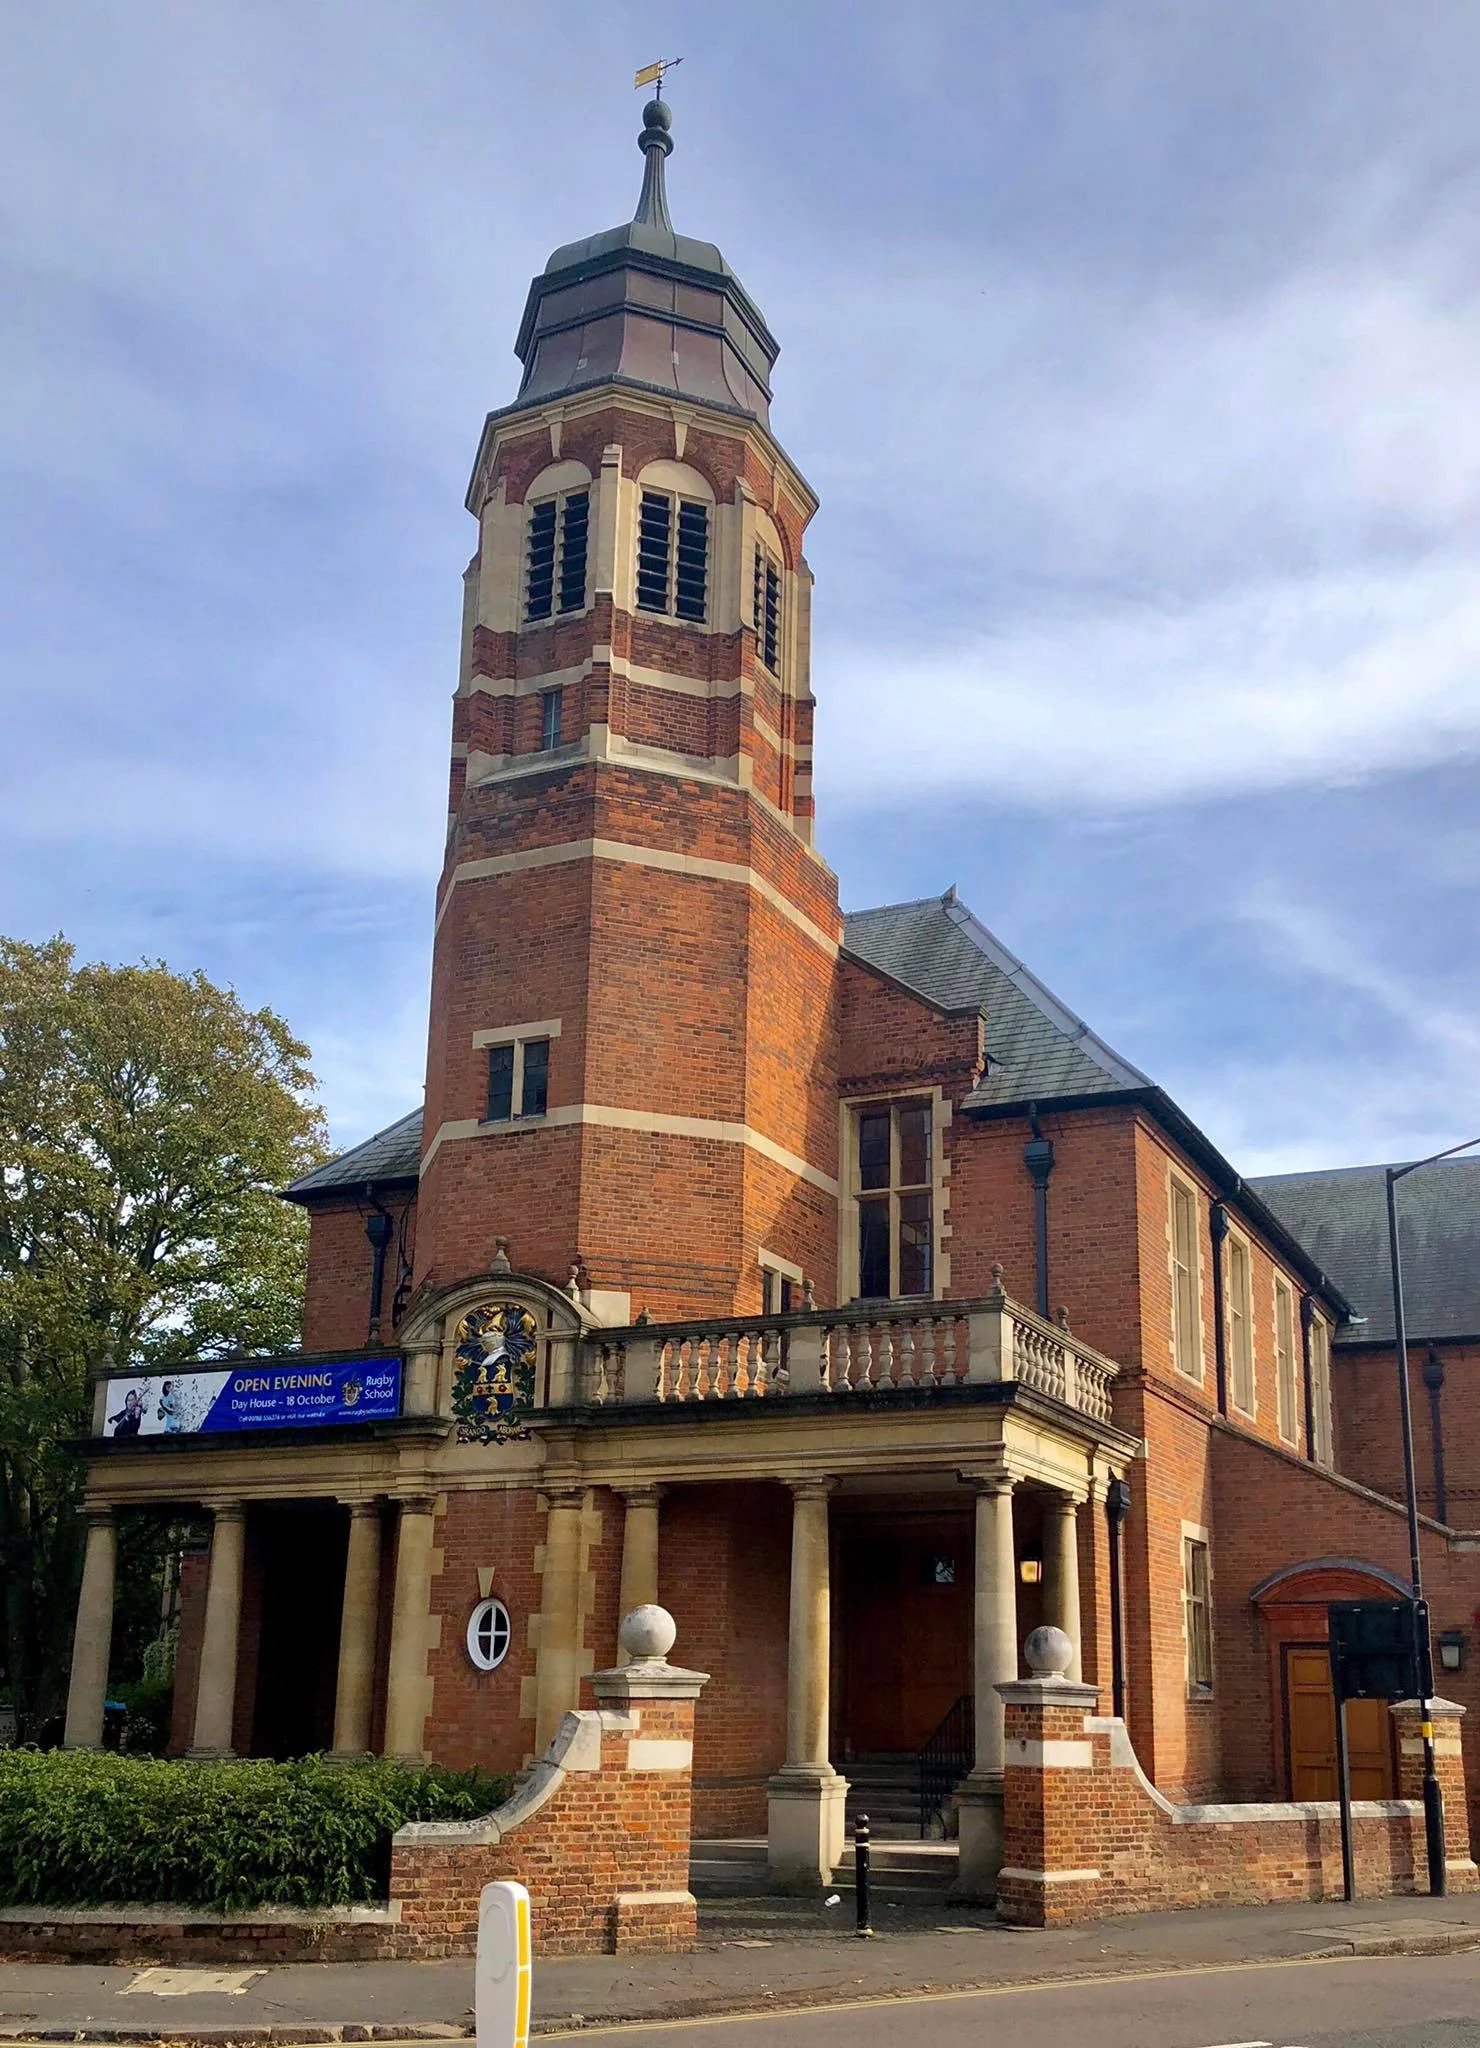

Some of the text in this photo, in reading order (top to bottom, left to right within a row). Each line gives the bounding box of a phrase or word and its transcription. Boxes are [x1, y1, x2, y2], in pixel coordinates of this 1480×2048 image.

[234, 1373, 332, 1392] OPEN EVENING
[366, 1374, 394, 1387] Rugby
[365, 1387, 393, 1399] School
[232, 1399, 248, 1411] Day
[249, 1398, 277, 1408] House
[286, 1396, 295, 1406] 18
[297, 1394, 335, 1405] October
